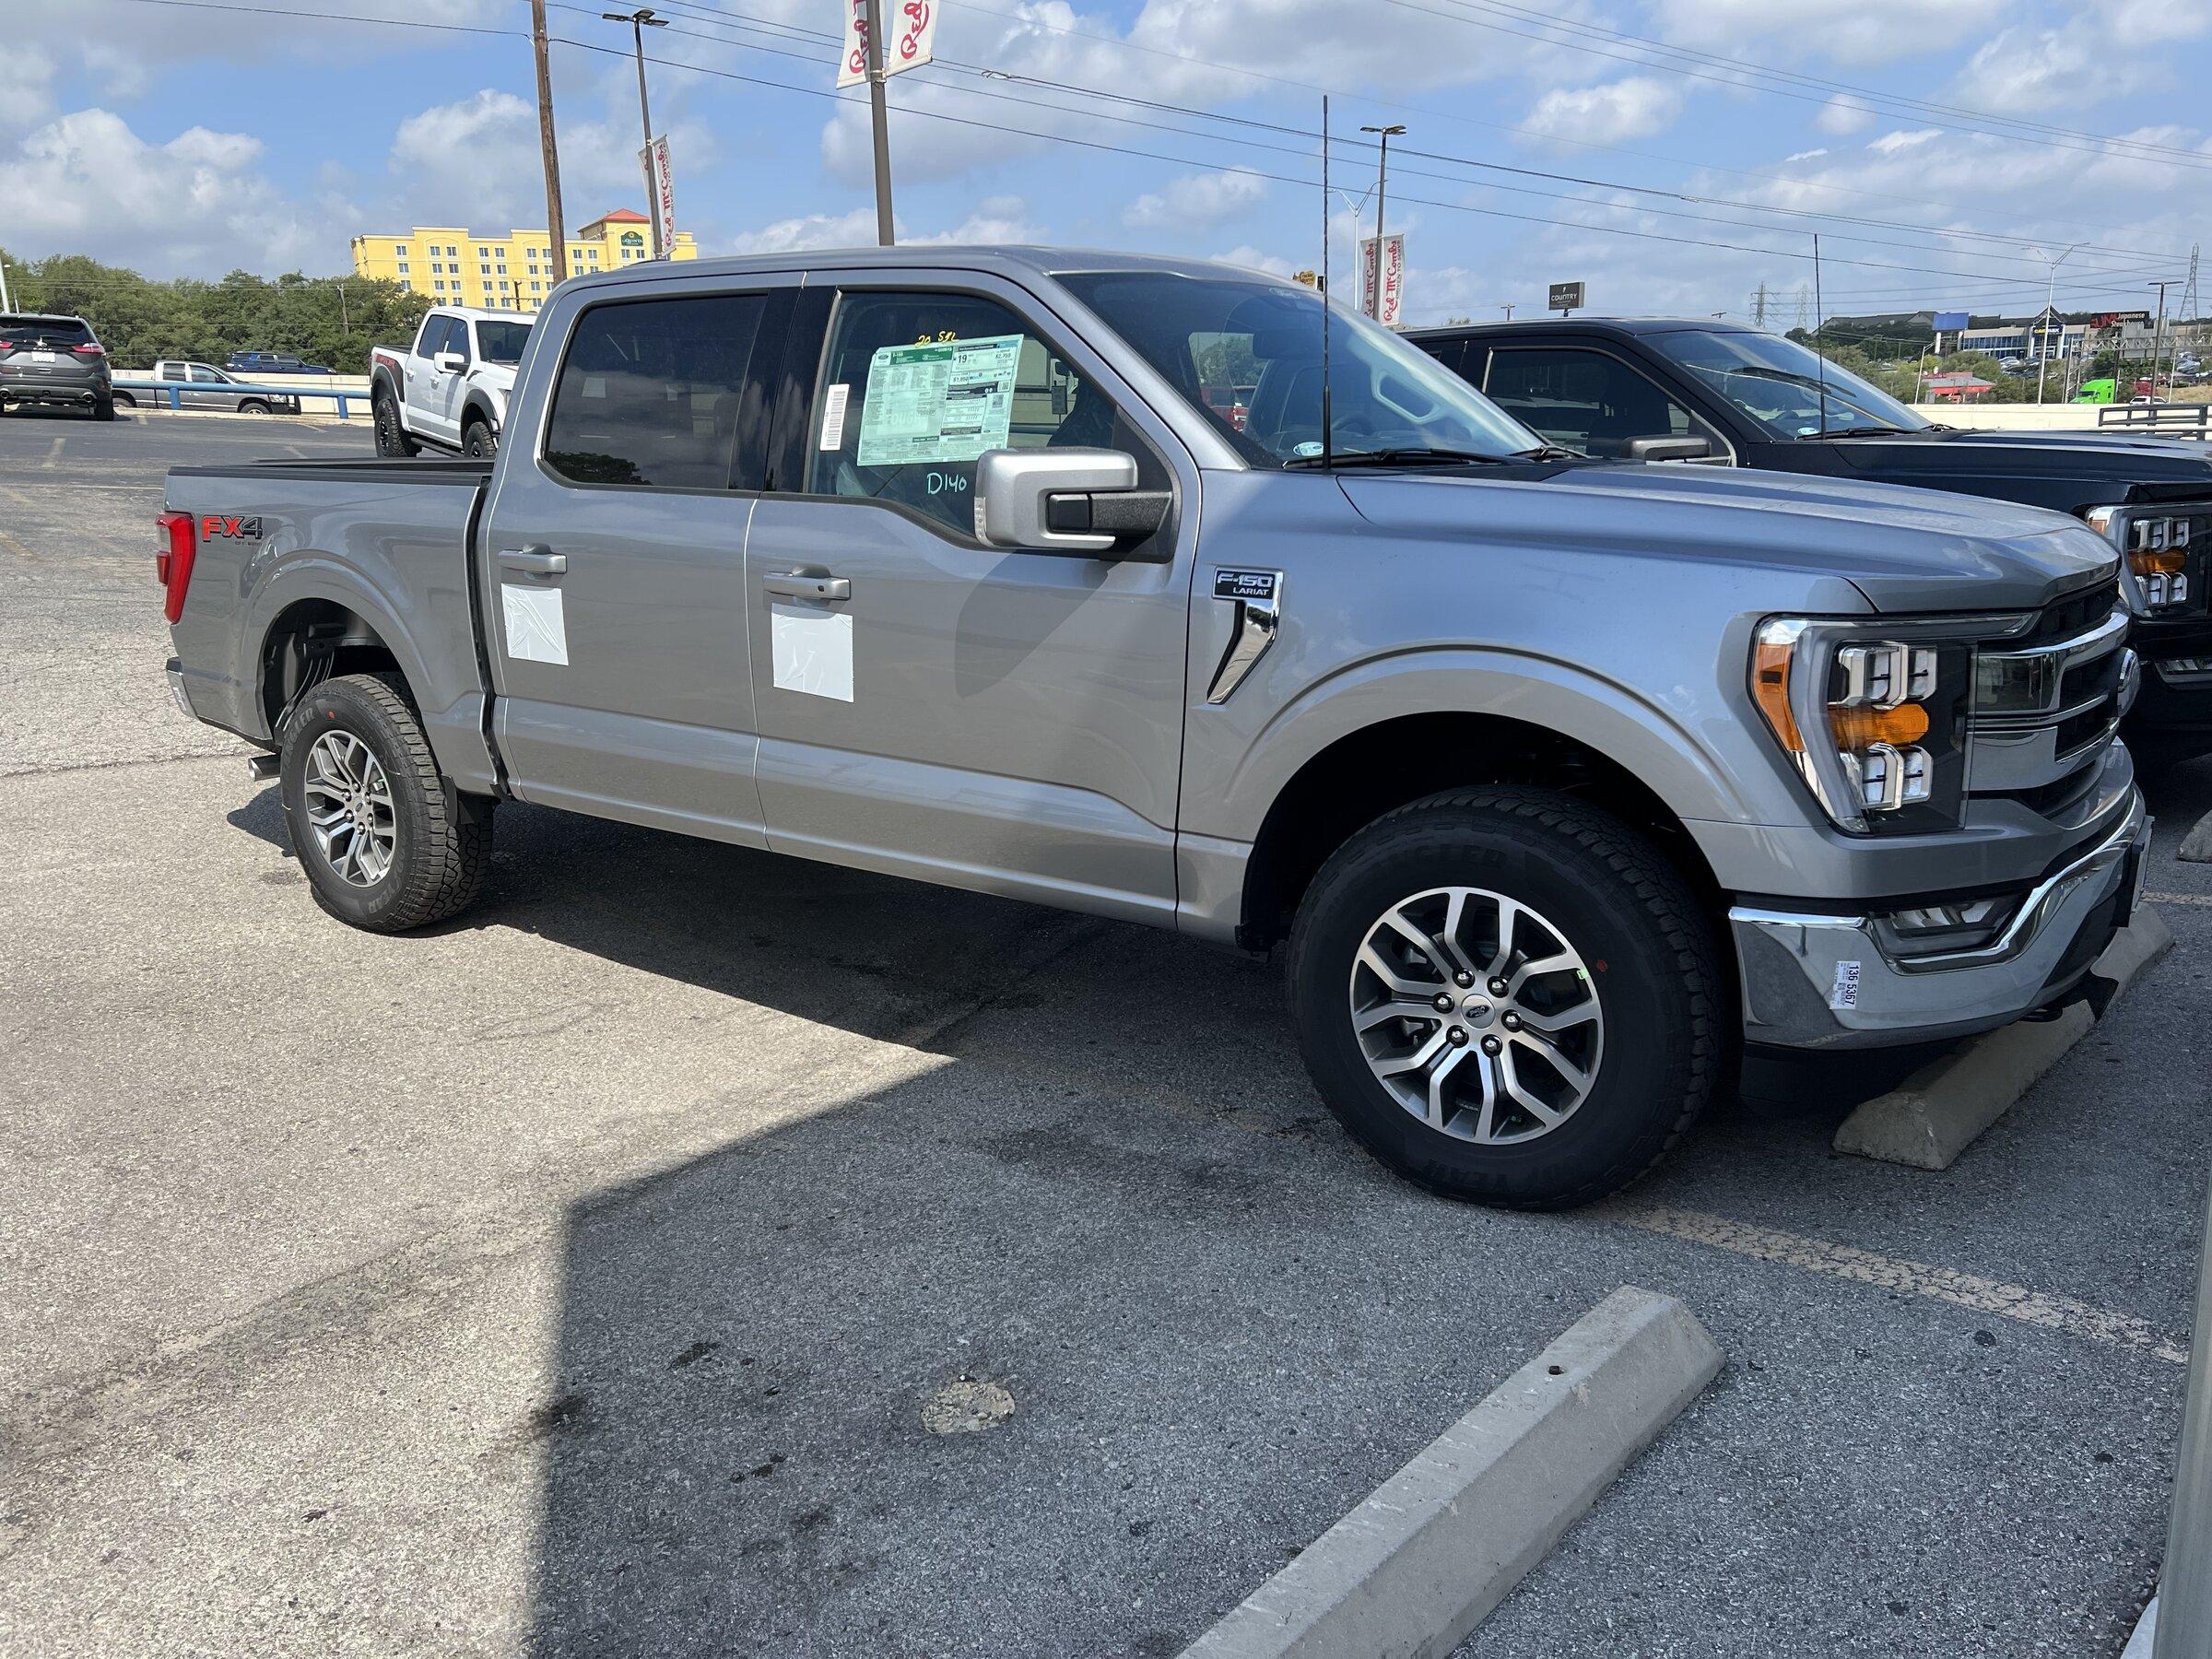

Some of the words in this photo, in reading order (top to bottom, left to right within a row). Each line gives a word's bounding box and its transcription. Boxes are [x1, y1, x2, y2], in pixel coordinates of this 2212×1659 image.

[900, 0, 930, 59] Red
[665, 217, 675, 247] Red
[1383, 297, 1398, 322] Red
[959, 354, 967, 363] 19
[926, 472, 968, 495] D140
[202, 515, 264, 543] FX4
[1217, 572, 1274, 588] F-150
[1232, 587, 1269, 596] LARIAT
[1848, 965, 1860, 981] 136
[1845, 983, 1857, 1005] 5367
